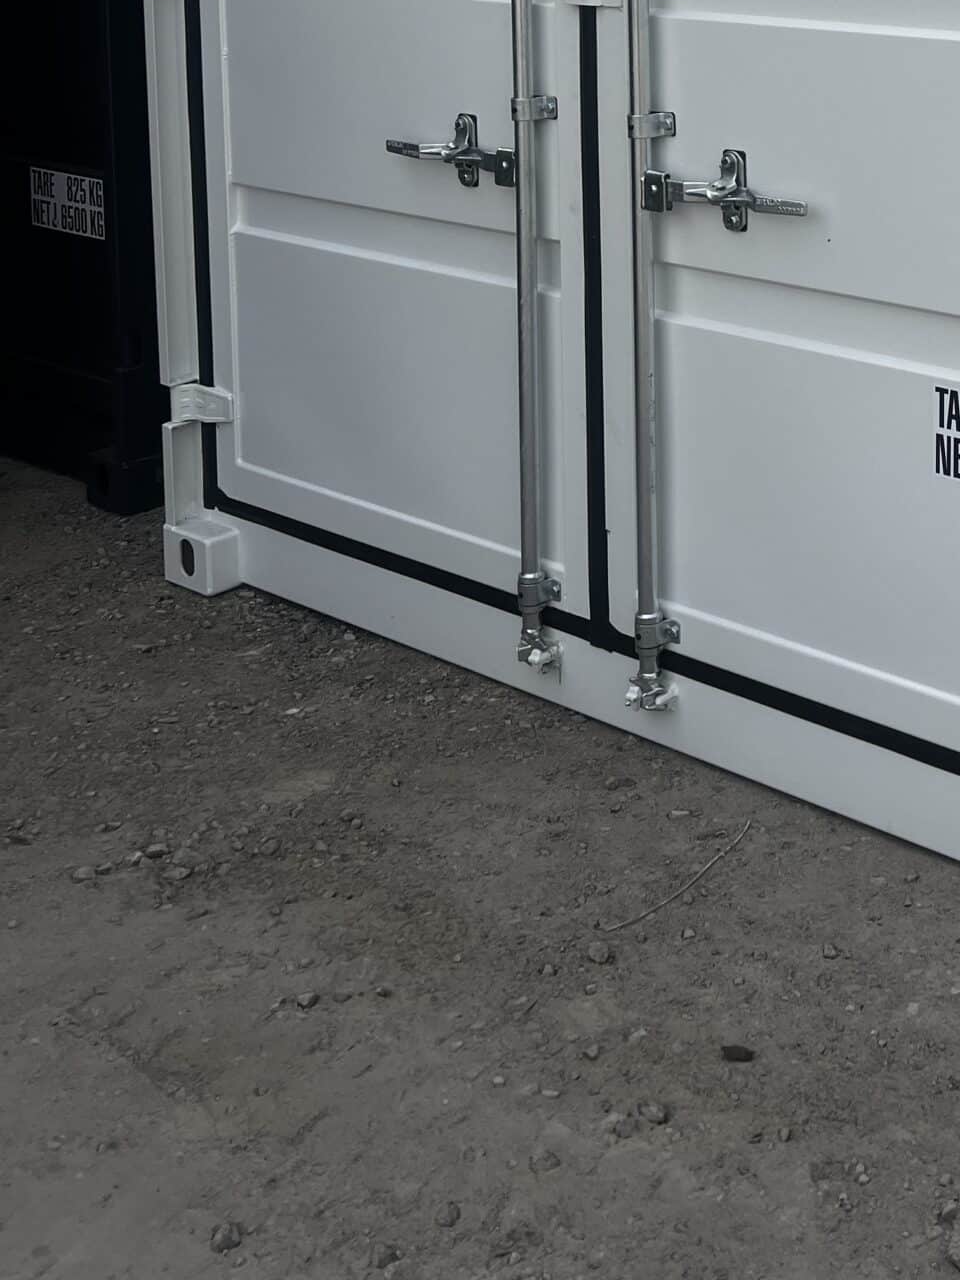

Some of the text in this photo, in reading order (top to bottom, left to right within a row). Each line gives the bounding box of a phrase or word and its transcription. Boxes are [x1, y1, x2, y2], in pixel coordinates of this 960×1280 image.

[32, 169, 103, 208] TARE 825 KG
[33, 198, 104, 238] NET 6500 KG
